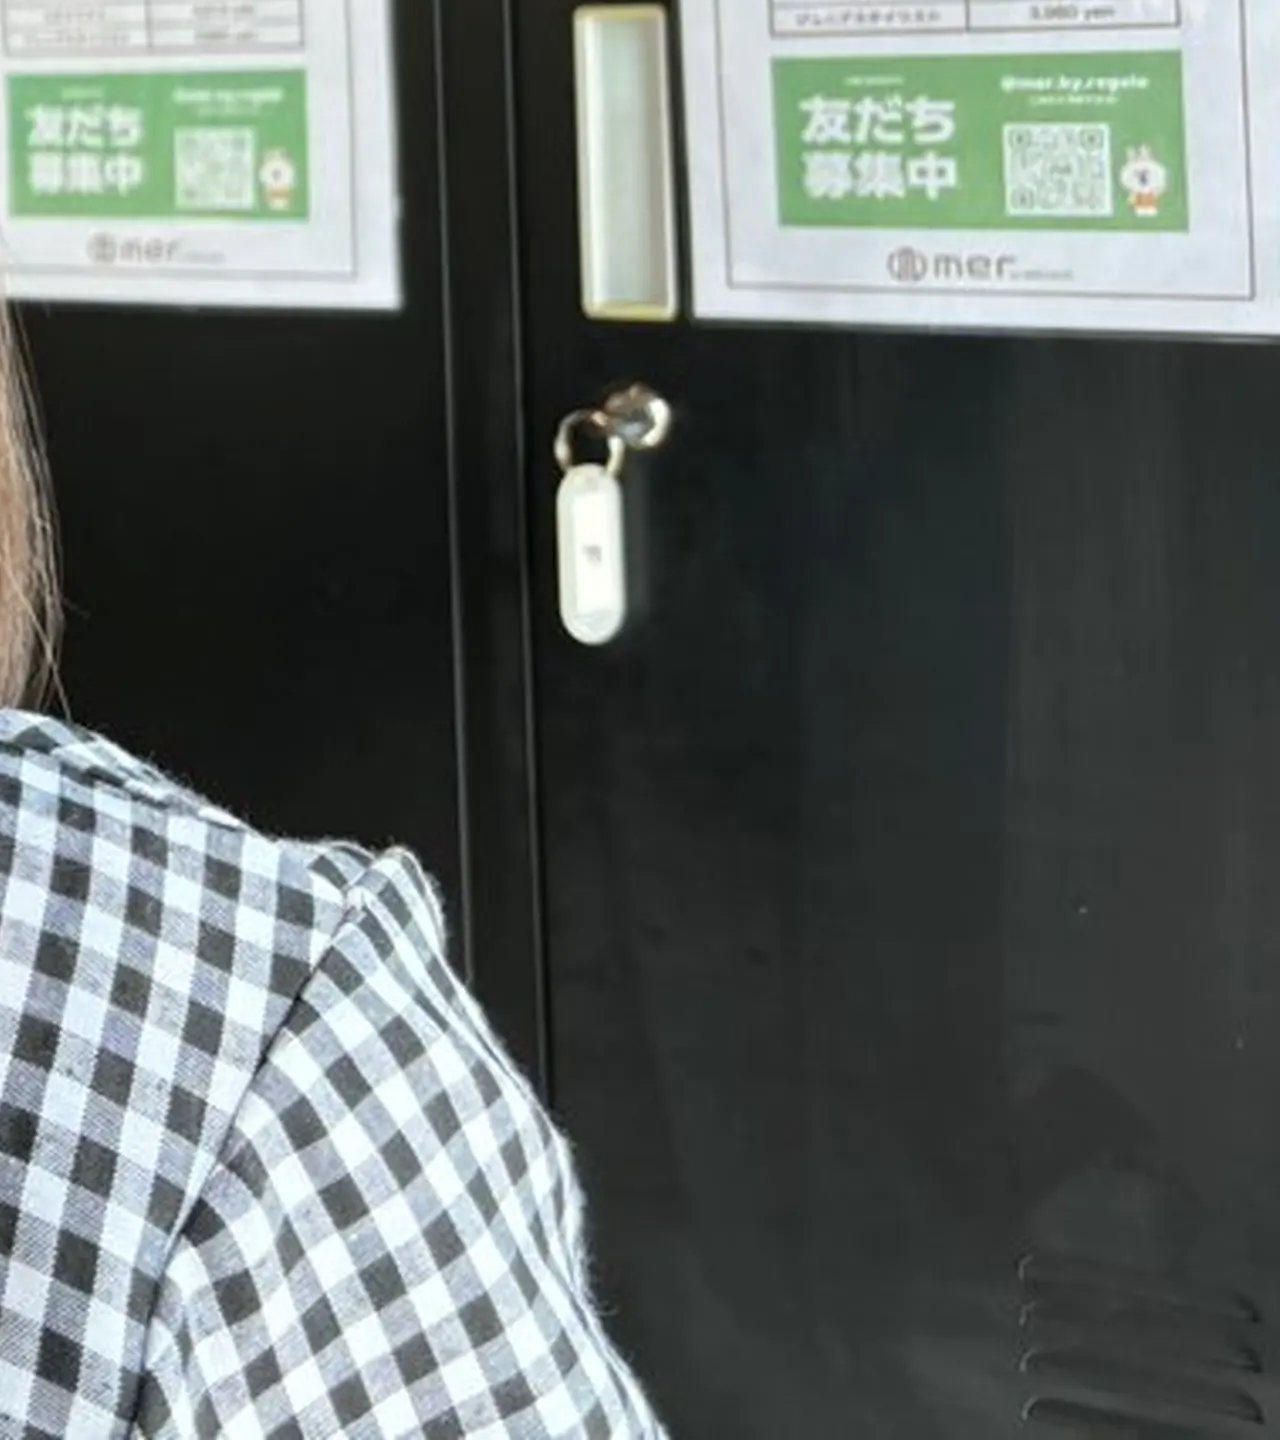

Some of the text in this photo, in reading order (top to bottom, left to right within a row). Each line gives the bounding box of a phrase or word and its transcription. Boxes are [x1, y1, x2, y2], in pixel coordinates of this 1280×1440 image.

[798, 94, 956, 145] 友だち
[801, 150, 958, 201] 募集中
[933, 252, 1016, 279] mer
